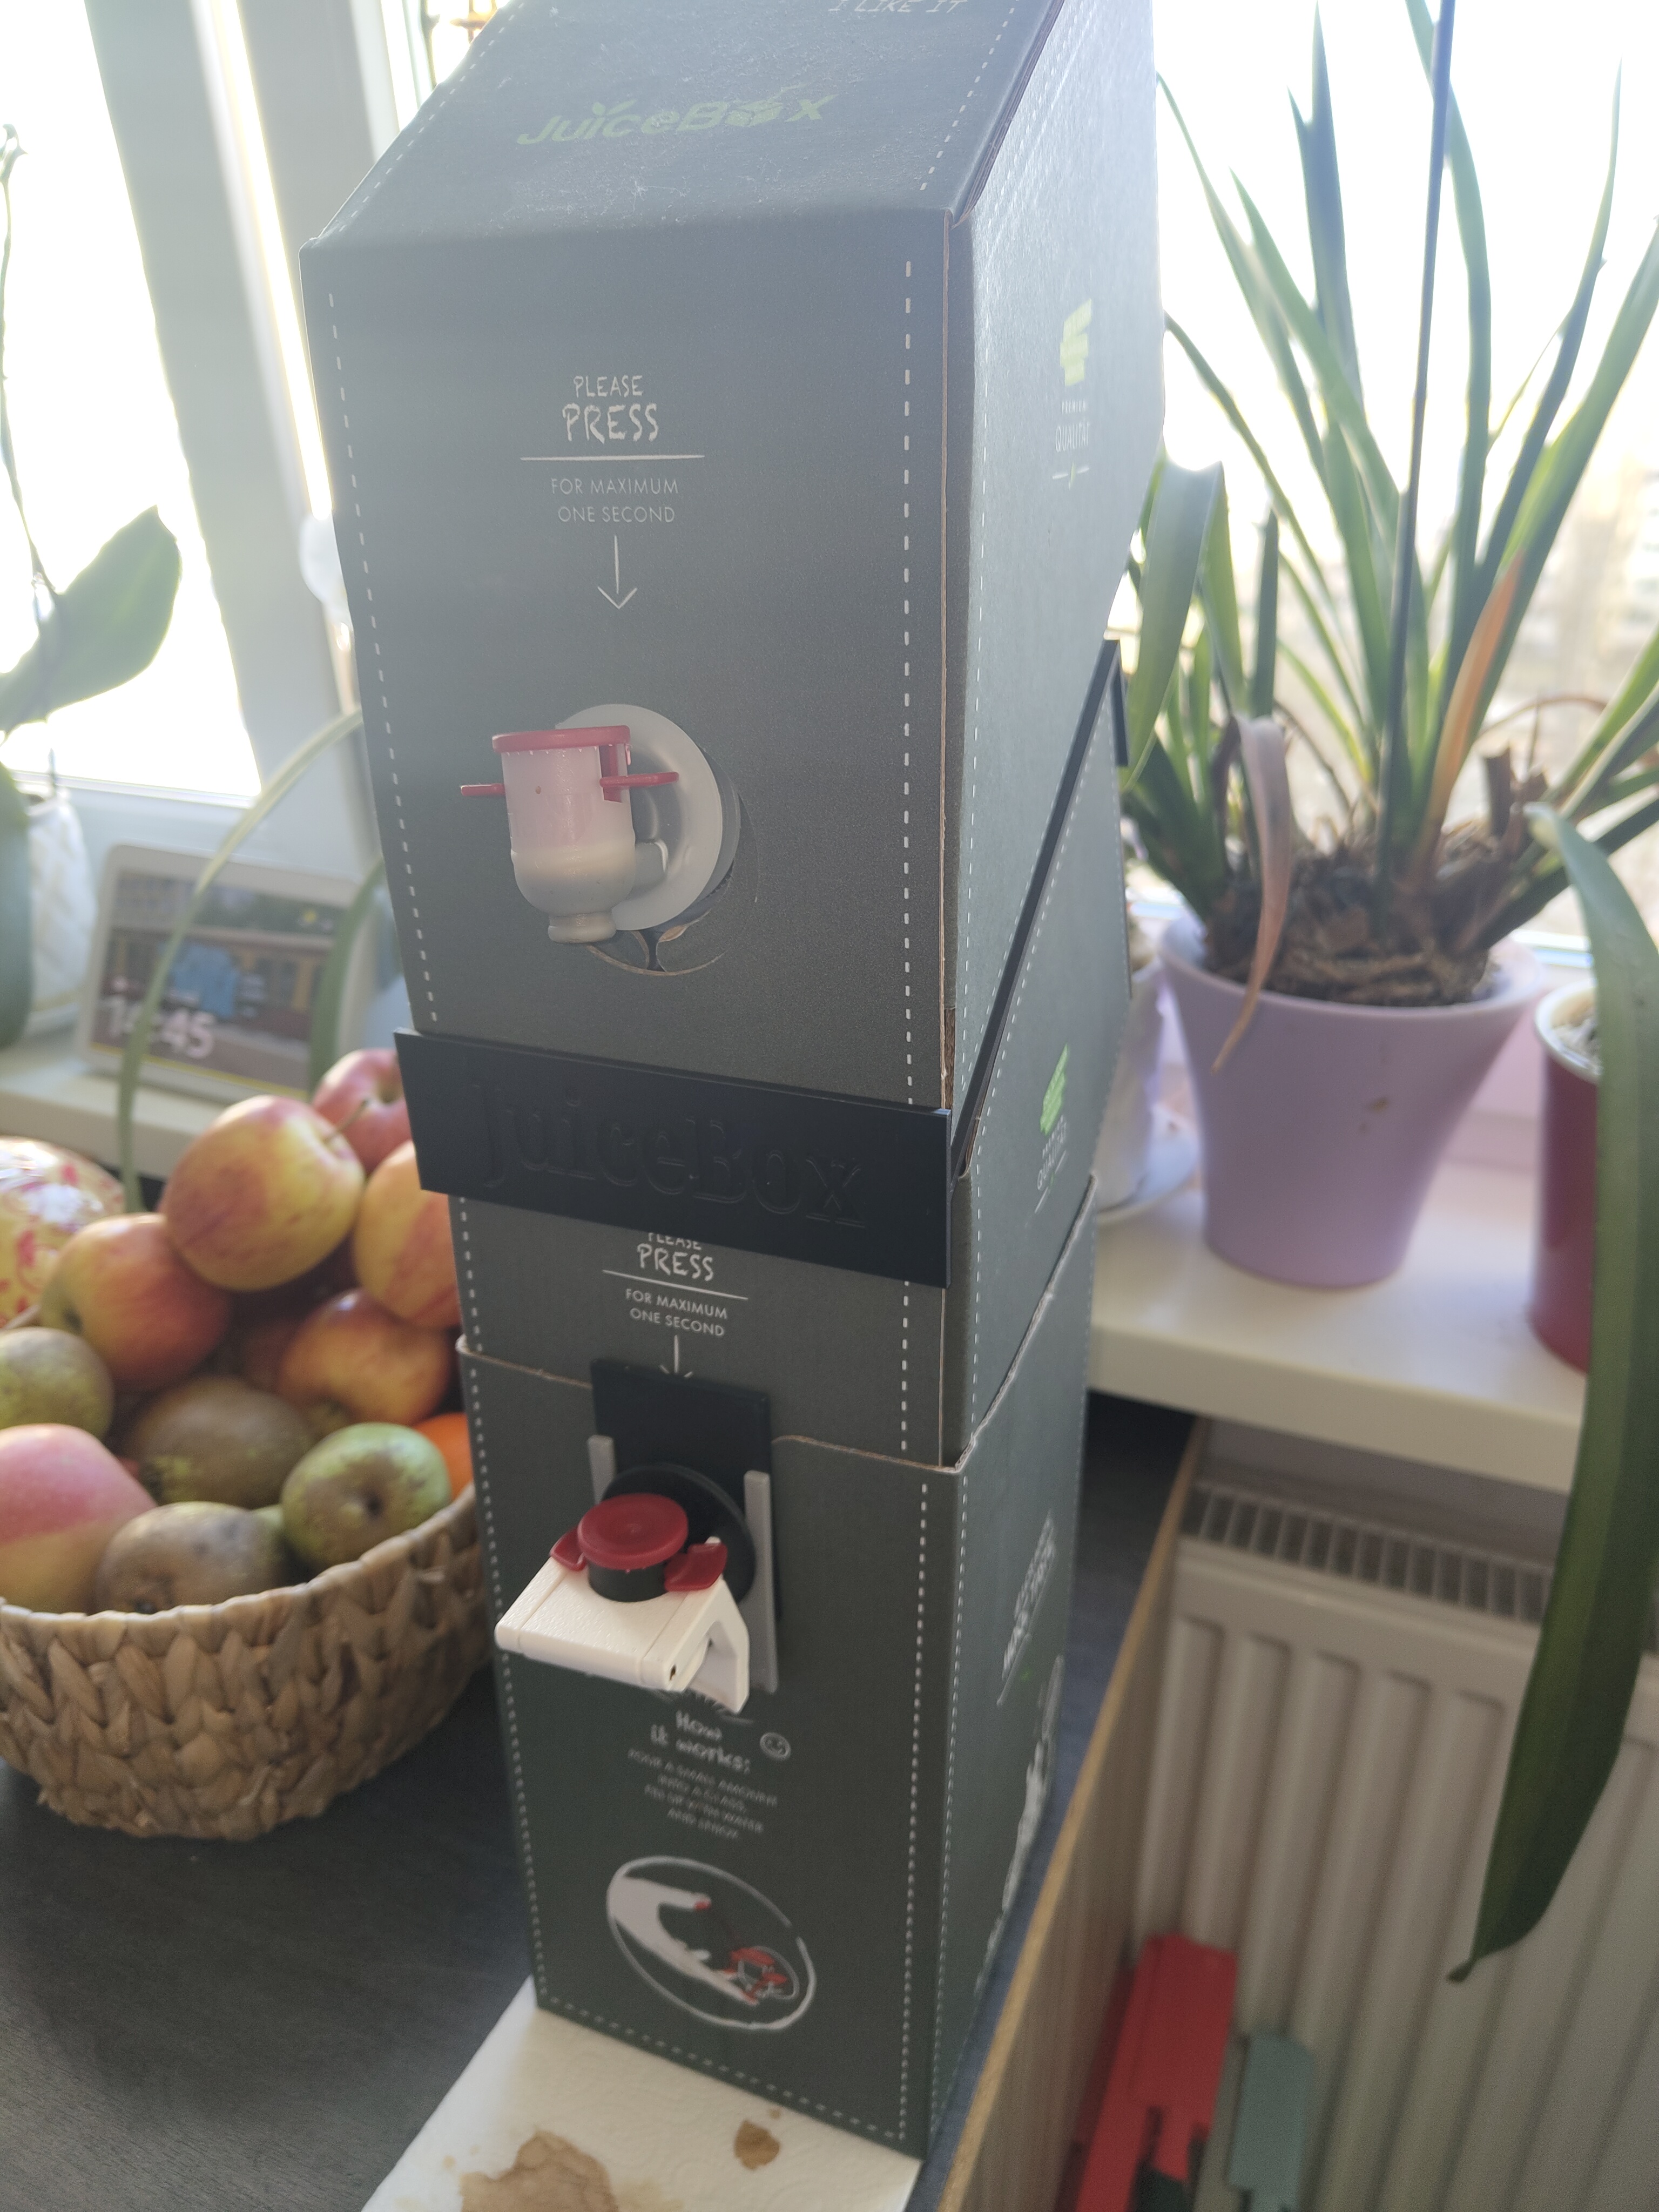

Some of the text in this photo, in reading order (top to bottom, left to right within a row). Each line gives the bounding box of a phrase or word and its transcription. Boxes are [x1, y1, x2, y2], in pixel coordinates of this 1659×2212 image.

[854, 0, 919, 12] LIKE
[925, 0, 968, 13] IT
[573, 375, 644, 397] PLEASE
[562, 403, 659, 444] PRESS
[551, 478, 679, 495] FOR MAXIMUM
[557, 506, 675, 522] ONE SECOND
[637, 1243, 714, 1282] PRESS
[625, 1288, 727, 1319] FOR MAXIMUM
[629, 1307, 725, 1337] ONE SECOND
